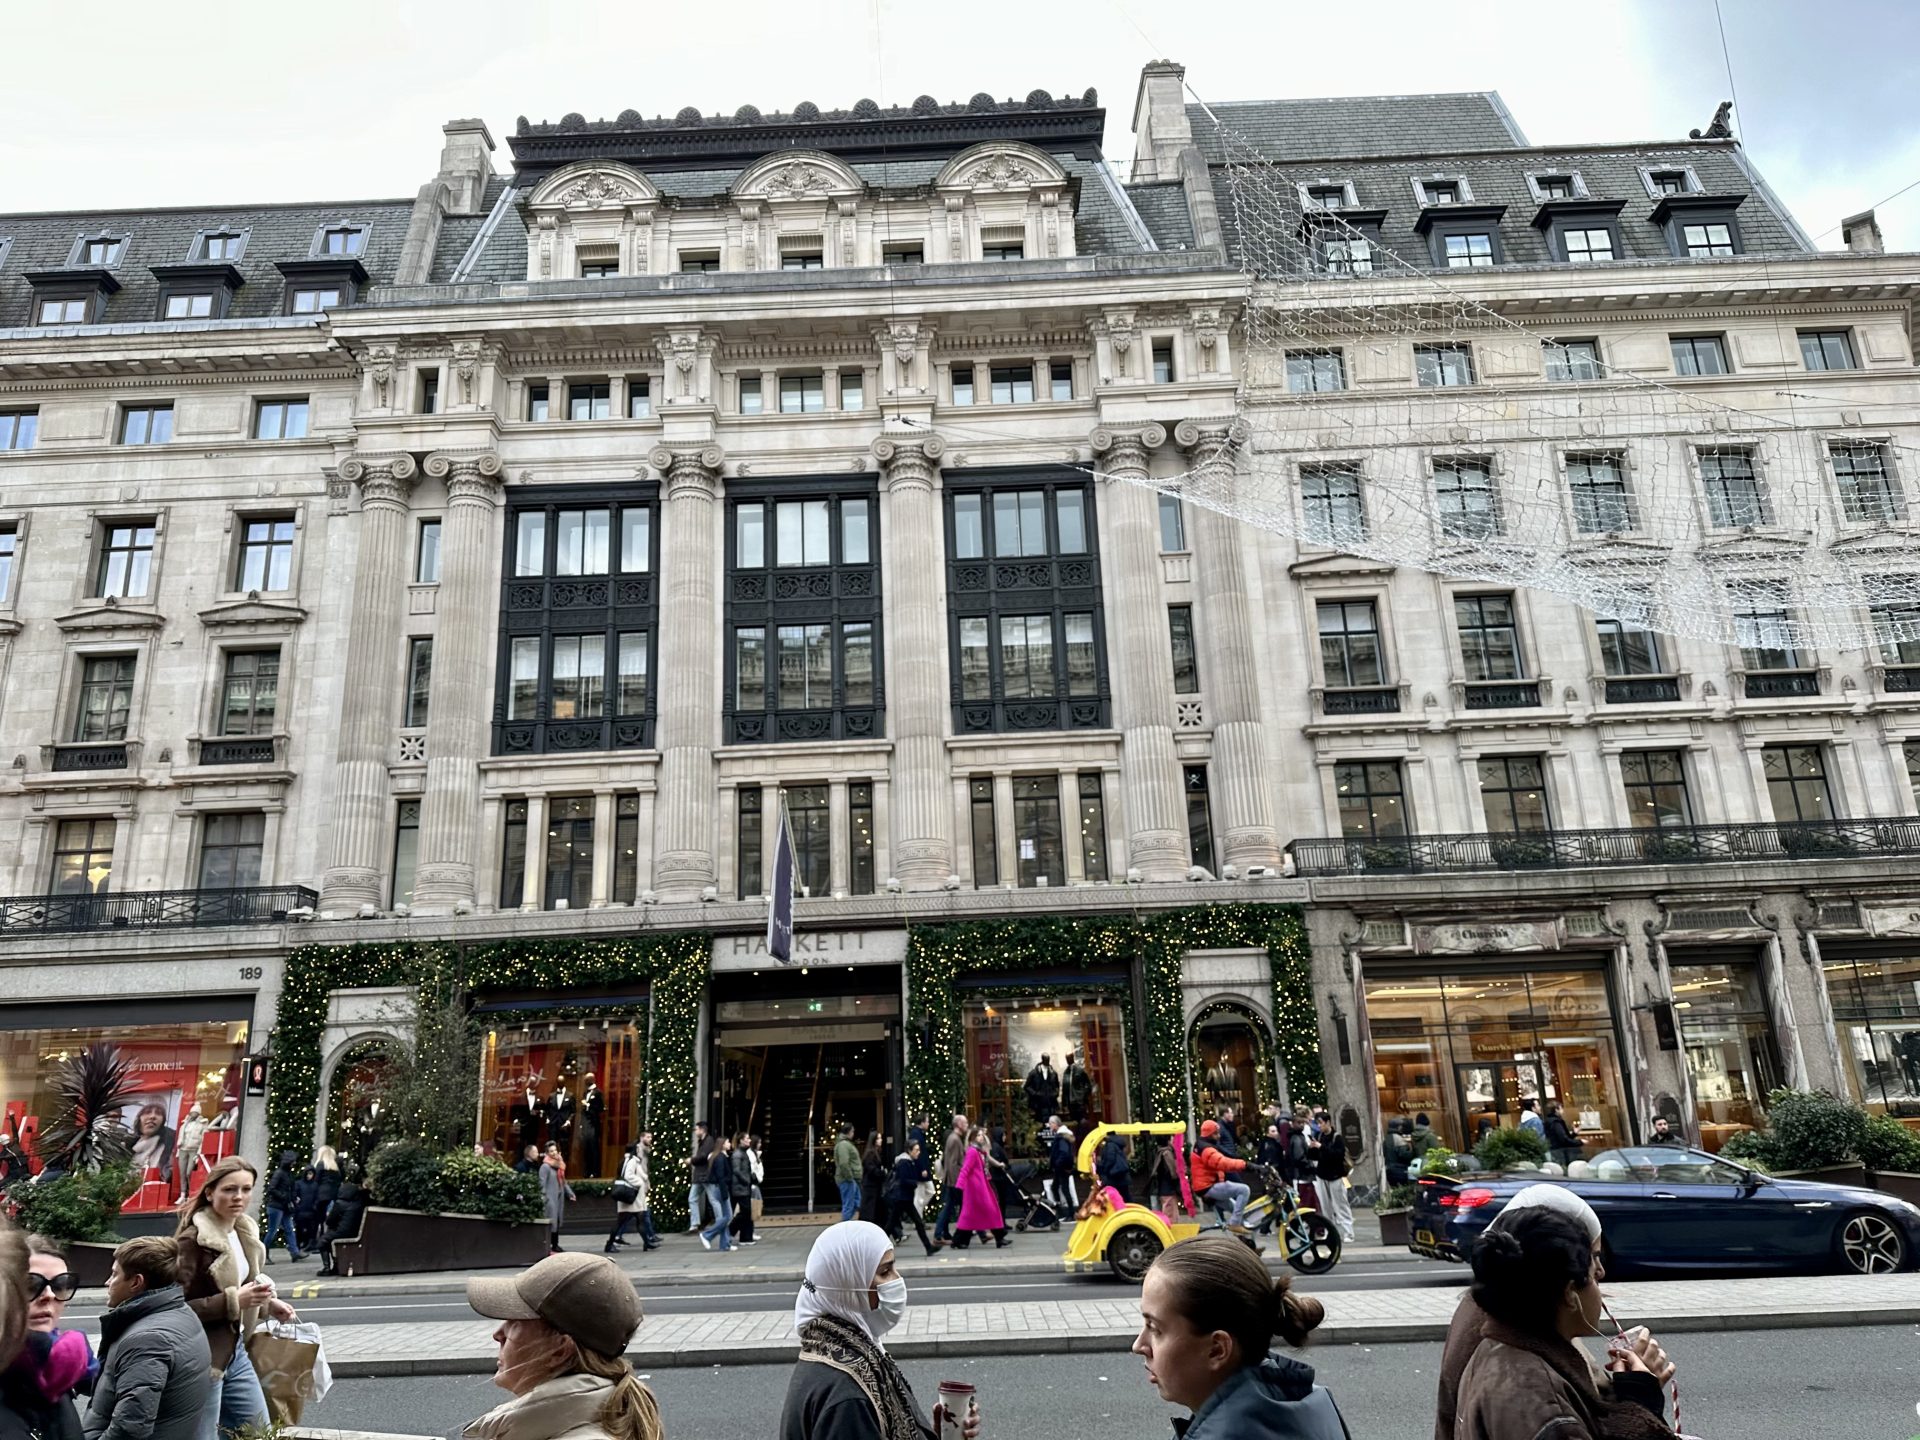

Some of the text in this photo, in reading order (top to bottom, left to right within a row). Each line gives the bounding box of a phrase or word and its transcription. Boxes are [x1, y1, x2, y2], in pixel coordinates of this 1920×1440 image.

[1462, 928, 1509, 939] Church's
[733, 931, 868, 955] HAKETT
[773, 957, 829, 967] LNDON
[239, 967, 262, 980] 189
[139, 1060, 184, 1072] moment.
